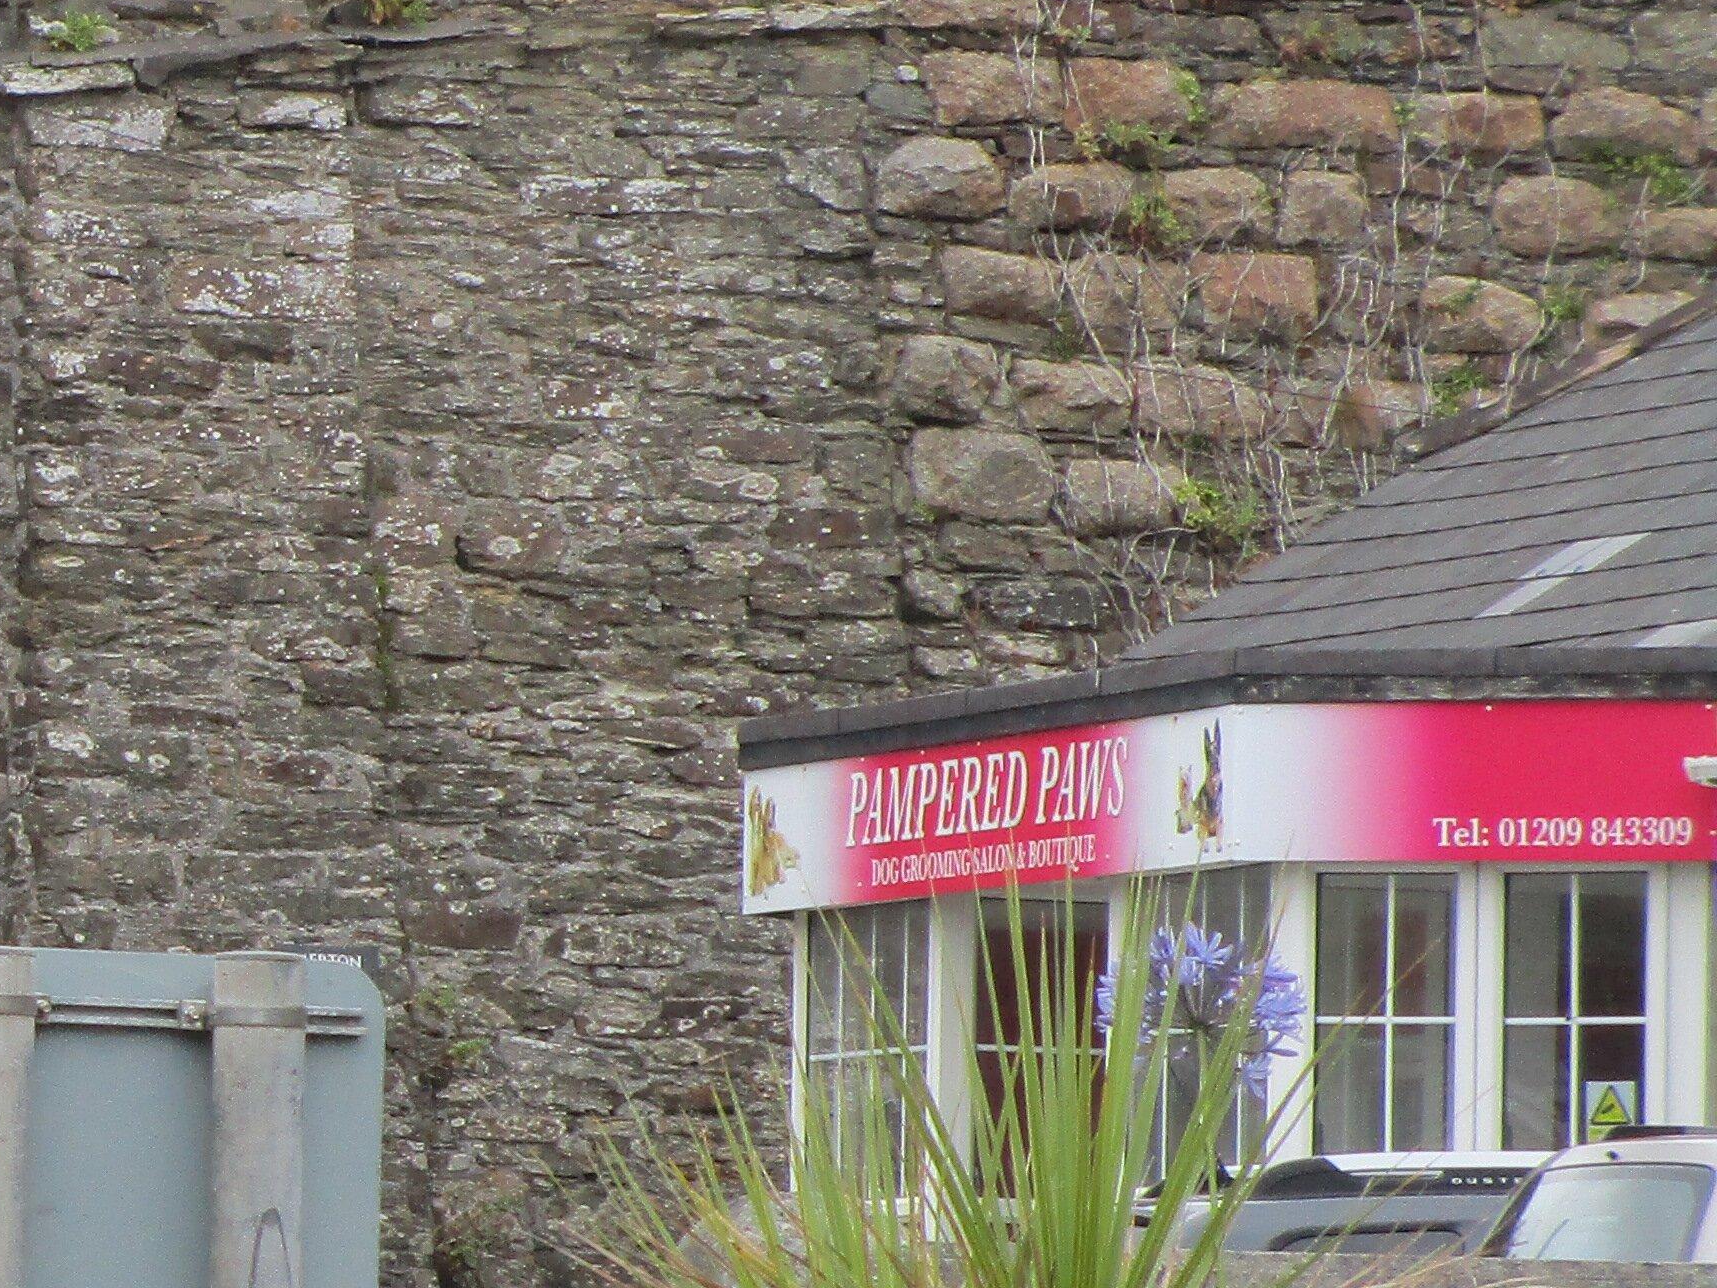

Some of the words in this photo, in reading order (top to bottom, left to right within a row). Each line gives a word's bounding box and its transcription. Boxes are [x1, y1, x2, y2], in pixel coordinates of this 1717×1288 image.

[846, 750, 1028, 847] PAMPERED
[1035, 737, 1129, 825] PAWS
[1432, 817, 1490, 847] Tel:
[1498, 816, 1583, 847] 01209
[1590, 816, 1694, 847] 843309
[871, 857, 899, 887] DOG
[901, 848, 971, 883] GROOMING
[972, 842, 1016, 875] SALON
[1028, 833, 1097, 873] BOUTIQUE
